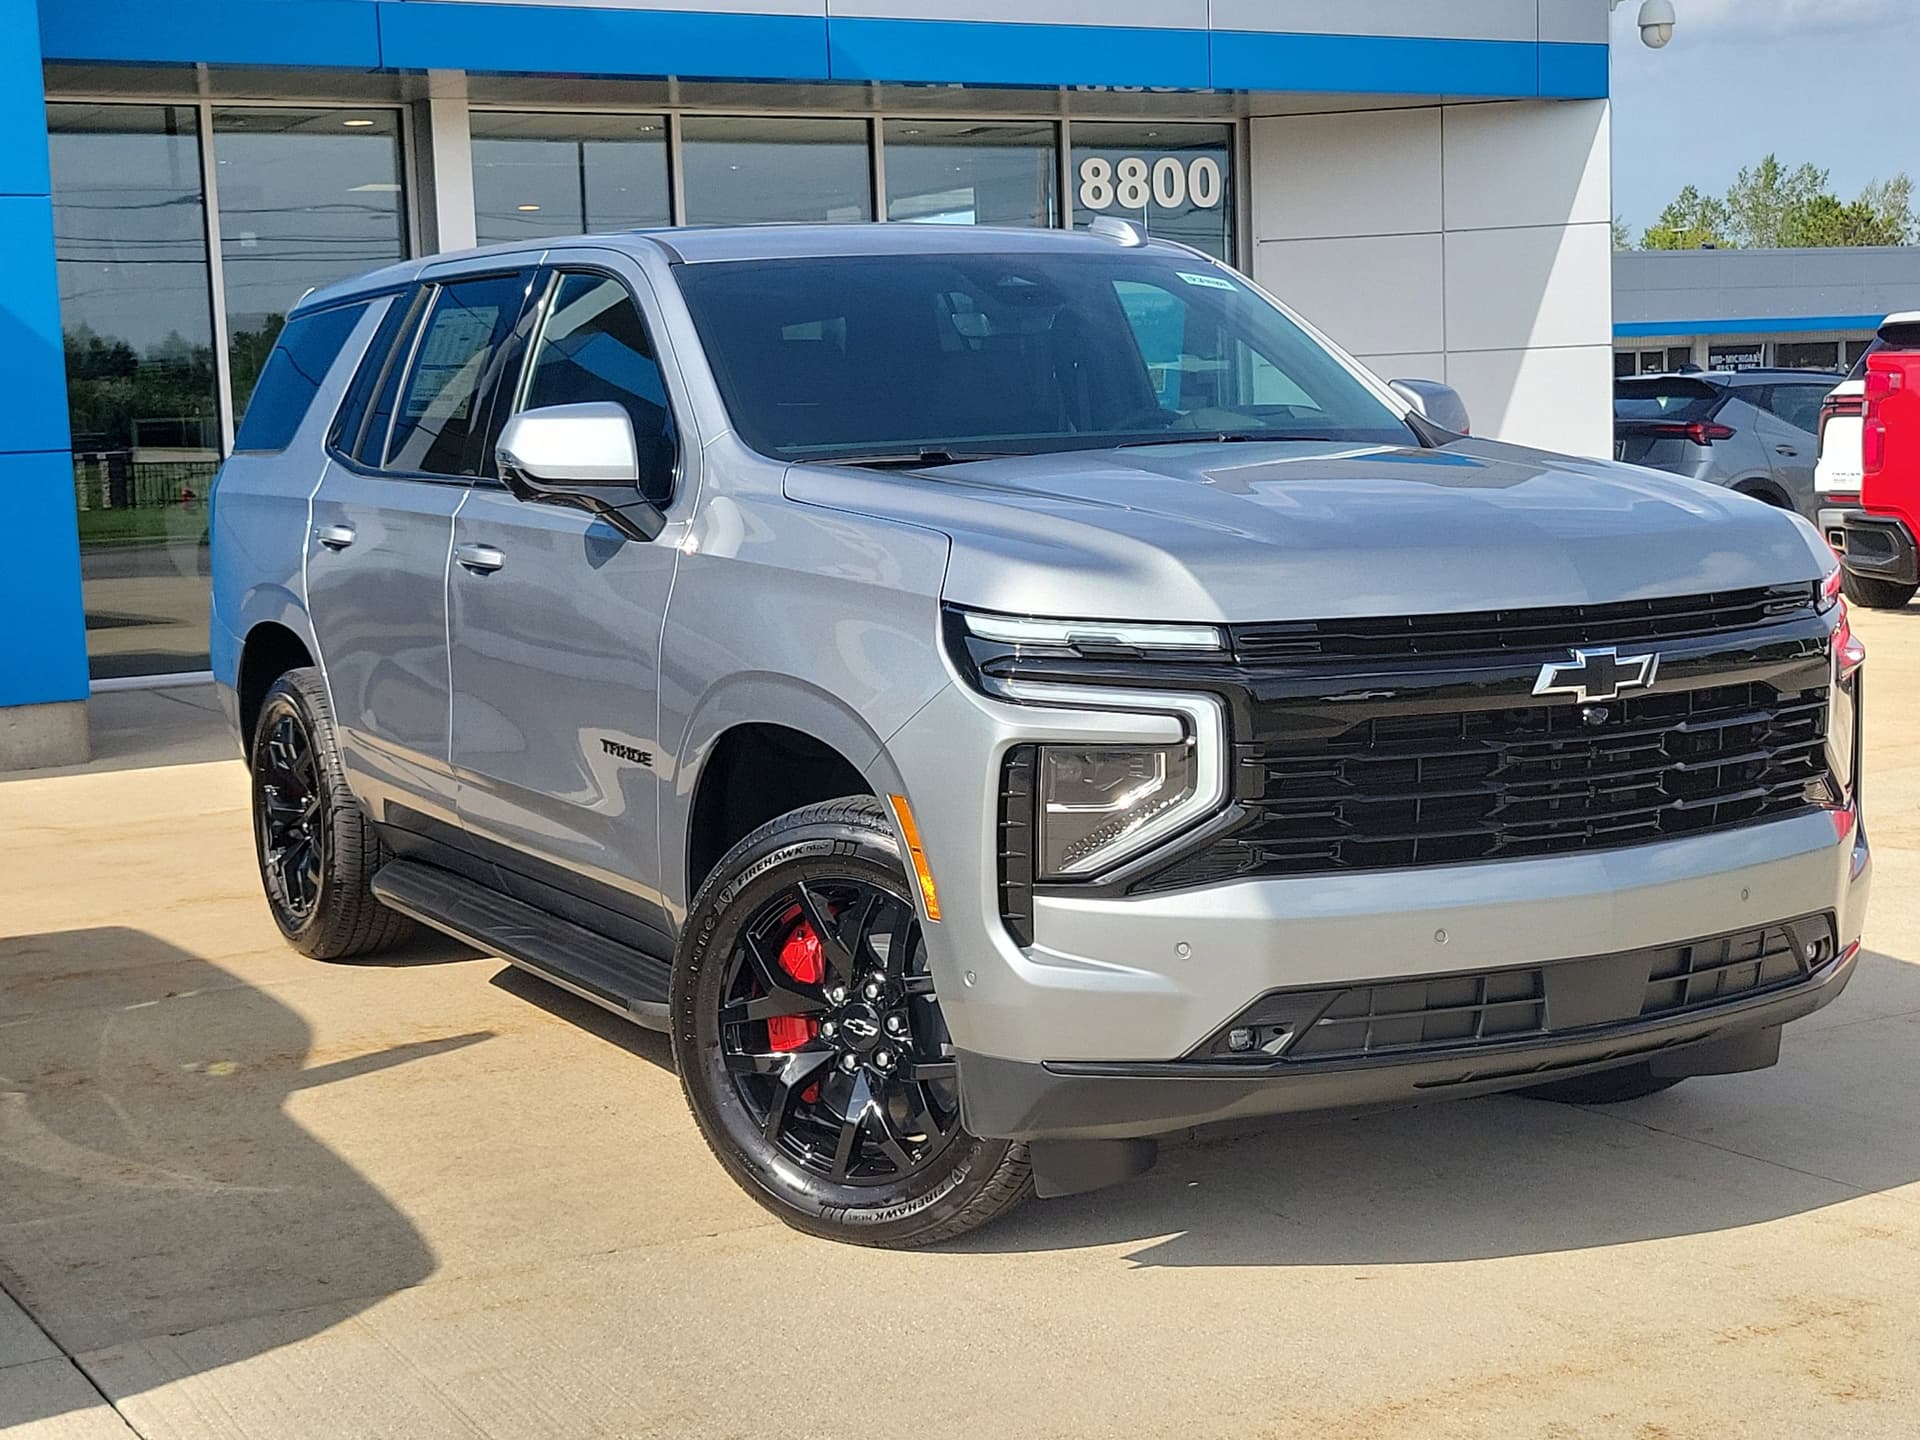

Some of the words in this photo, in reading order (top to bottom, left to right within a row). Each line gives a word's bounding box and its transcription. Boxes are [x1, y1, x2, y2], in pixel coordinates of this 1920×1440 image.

[1079, 157, 1221, 209] 8800
[600, 739, 652, 767] TAHOE
[737, 846, 803, 887] FIREHAWK
[875, 1184, 946, 1221] FIREHAWK
